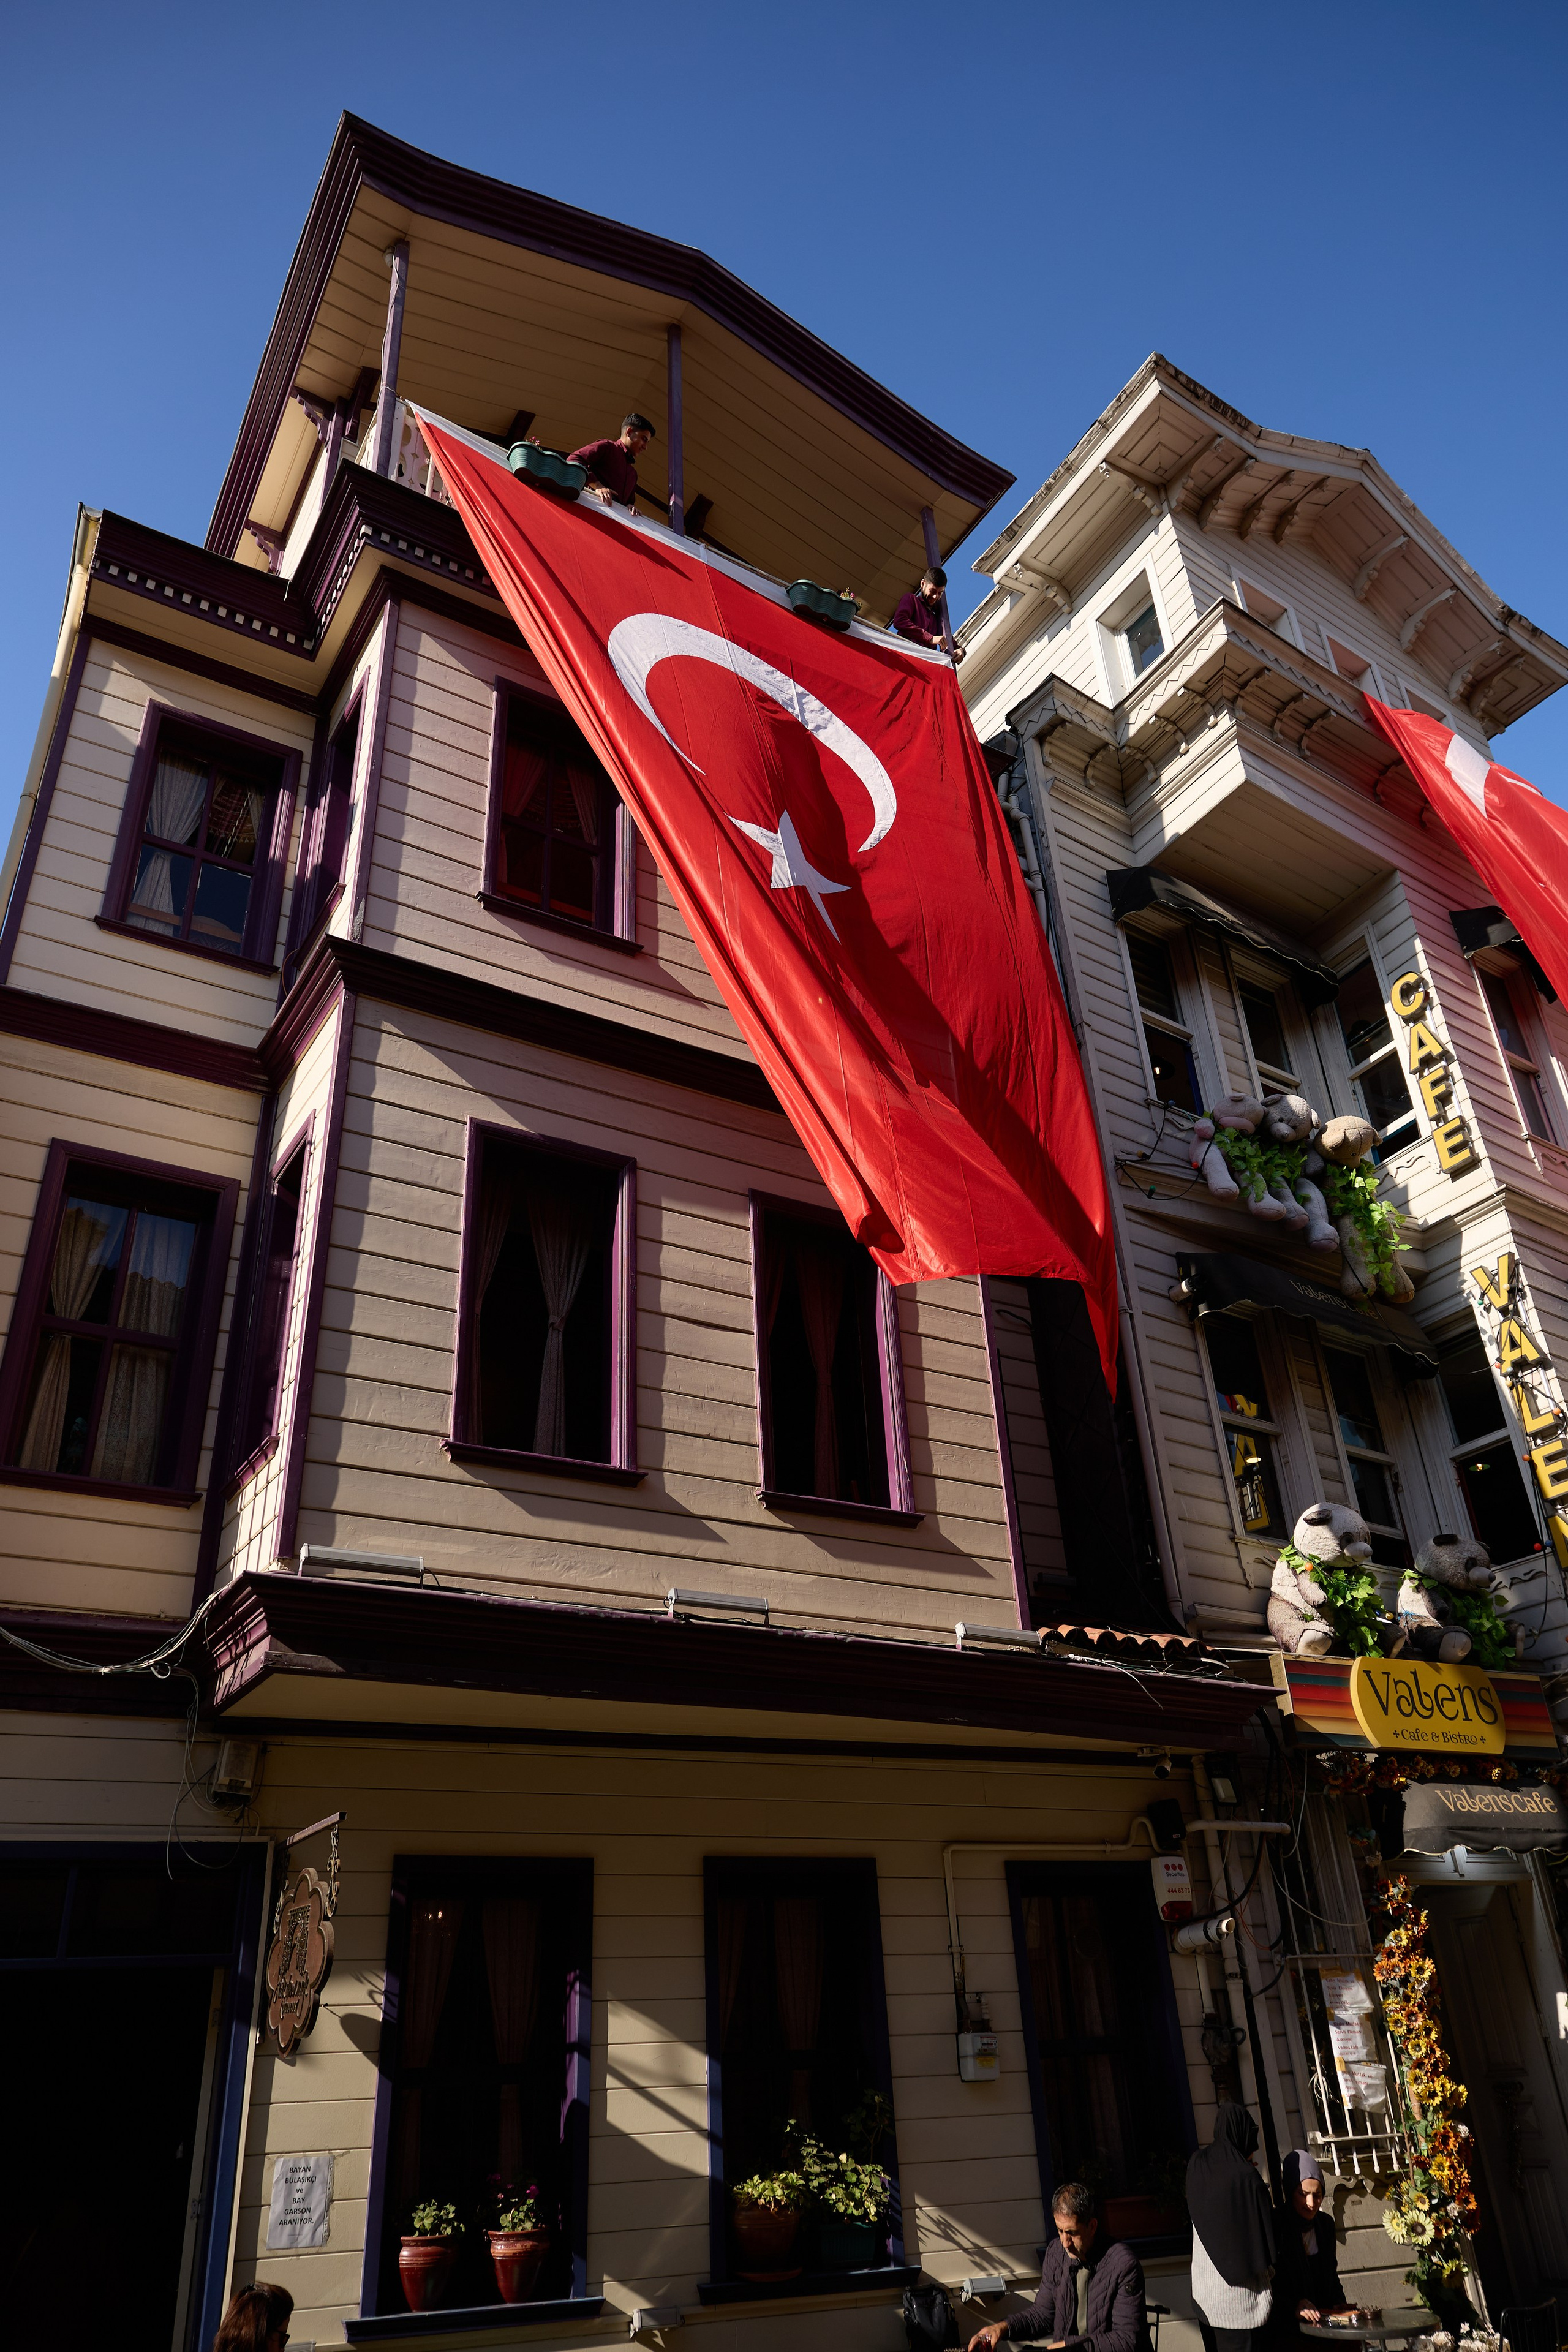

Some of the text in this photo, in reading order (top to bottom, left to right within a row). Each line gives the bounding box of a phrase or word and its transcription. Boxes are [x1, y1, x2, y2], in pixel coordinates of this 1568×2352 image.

[1390, 971, 1471, 1173] CAFE
[1401, 1728, 1429, 1741] Cafe
[1431, 1732, 1439, 1742] &
